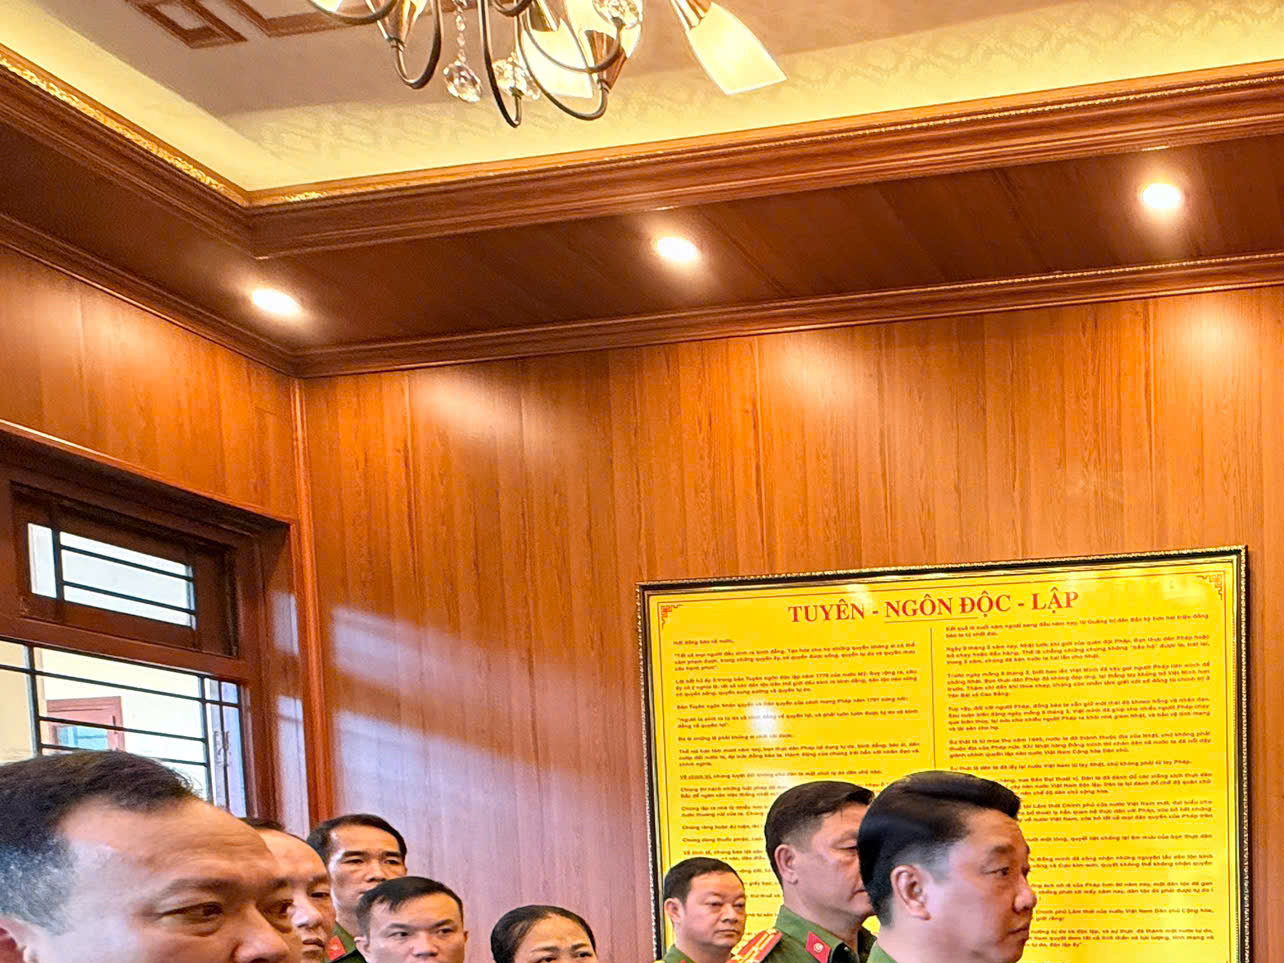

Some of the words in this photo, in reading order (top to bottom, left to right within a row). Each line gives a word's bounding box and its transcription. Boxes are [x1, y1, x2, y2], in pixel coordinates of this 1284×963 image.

[788, 599, 865, 623] TUYÊN
[884, 594, 953, 619] NGÔN
[959, 590, 1012, 618] ĐỘC
[1031, 586, 1080, 614] LẬP
